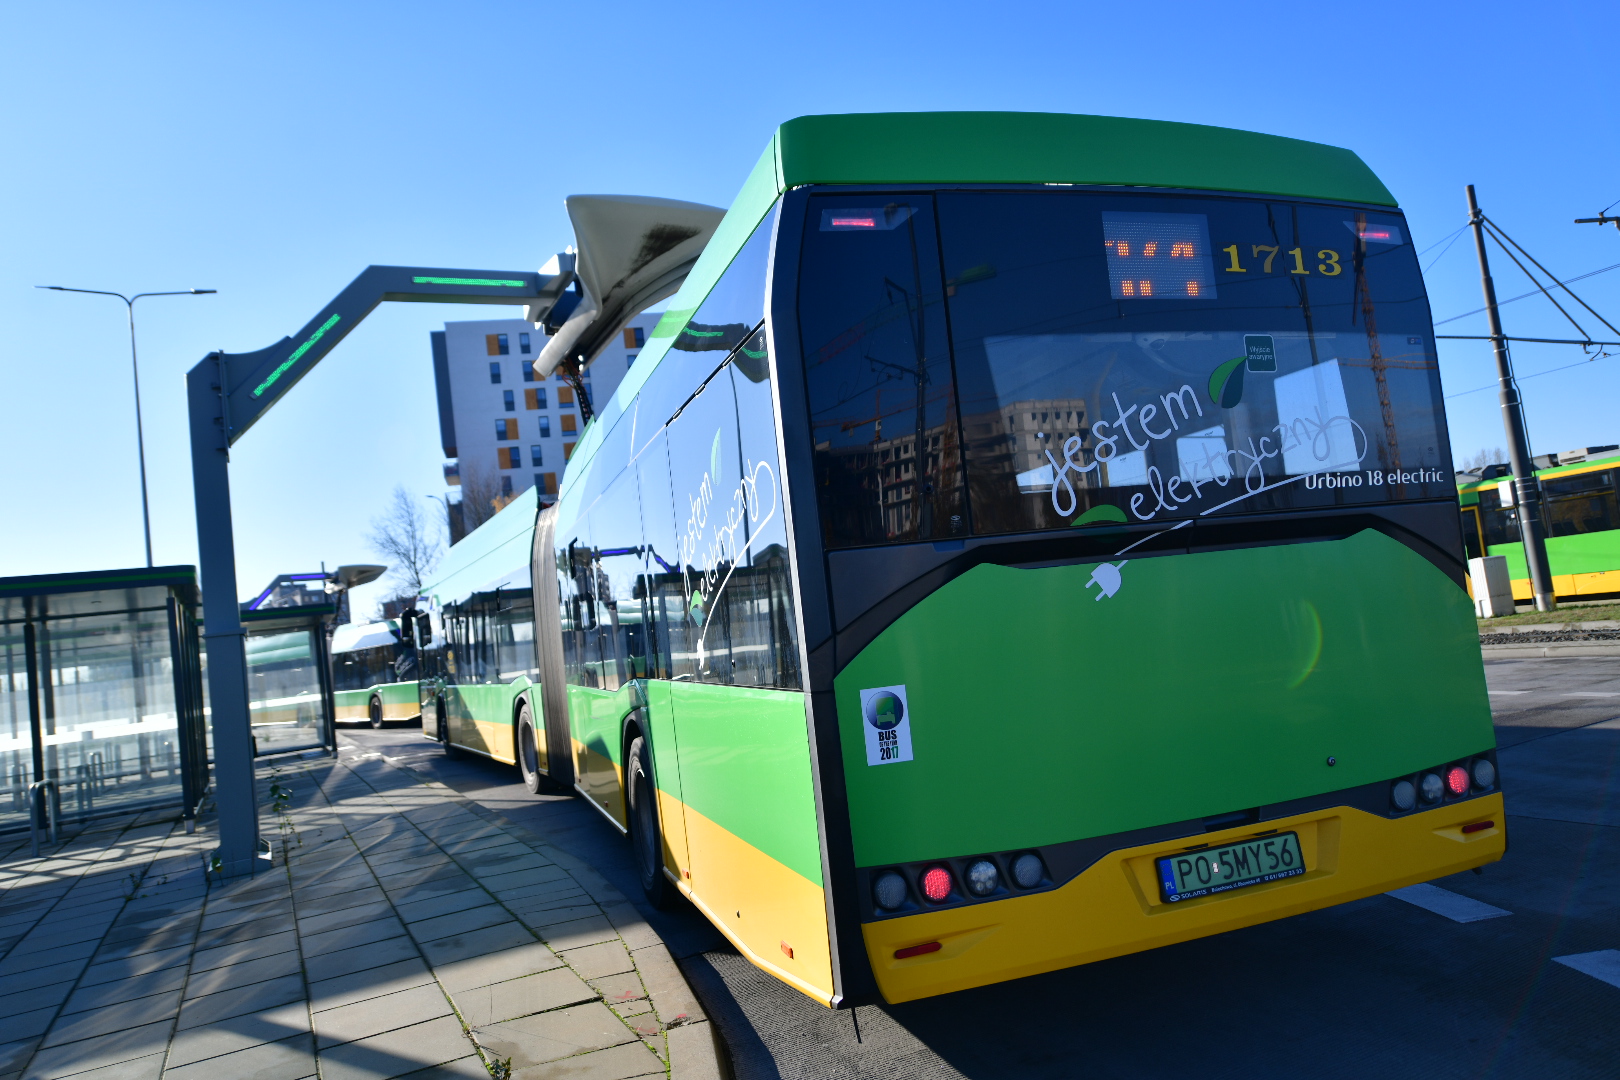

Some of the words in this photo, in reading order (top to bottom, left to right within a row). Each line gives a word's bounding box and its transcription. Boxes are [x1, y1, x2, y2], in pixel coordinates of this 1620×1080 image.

[1222, 244, 1342, 276] 1713
[1037, 384, 1203, 517] jestem
[1130, 405, 1367, 521] elektryczny
[1305, 472, 1363, 490] Urbino
[1366, 470, 1383, 486] 18
[1387, 468, 1444, 485] electric
[677, 471, 713, 602] jestem
[878, 729, 898, 741] BUS
[879, 745, 899, 760] 2017
[1176, 855, 1212, 890] PO
[1218, 838, 1294, 880] 5MY56
[1165, 881, 1175, 891] PL
[1180, 889, 1207, 899] SOLARIS
